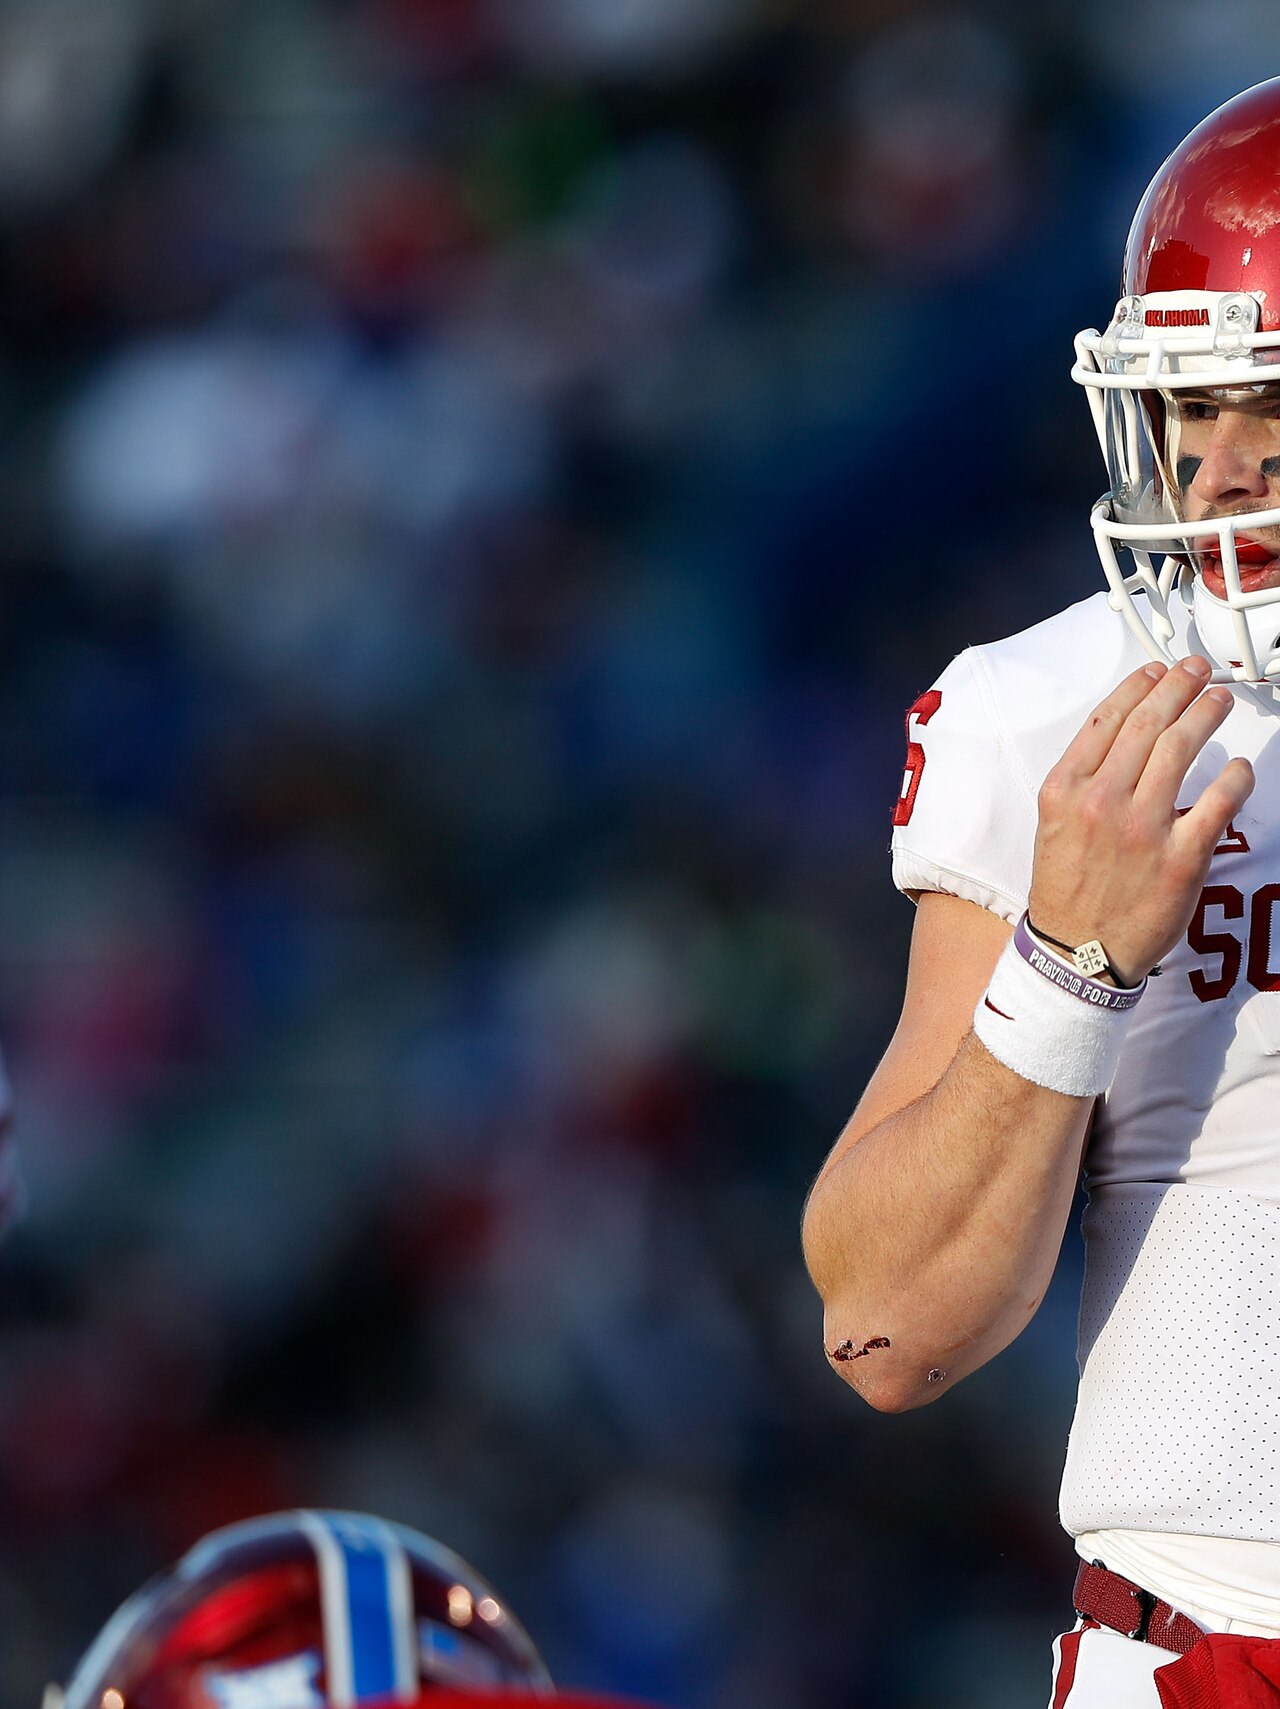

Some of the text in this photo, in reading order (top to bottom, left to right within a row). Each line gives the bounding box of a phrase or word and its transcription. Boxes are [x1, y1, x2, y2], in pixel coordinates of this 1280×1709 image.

[1145, 308, 1211, 327] OKLAHOMA
[1028, 948, 1111, 1007] PRAYING FOR
